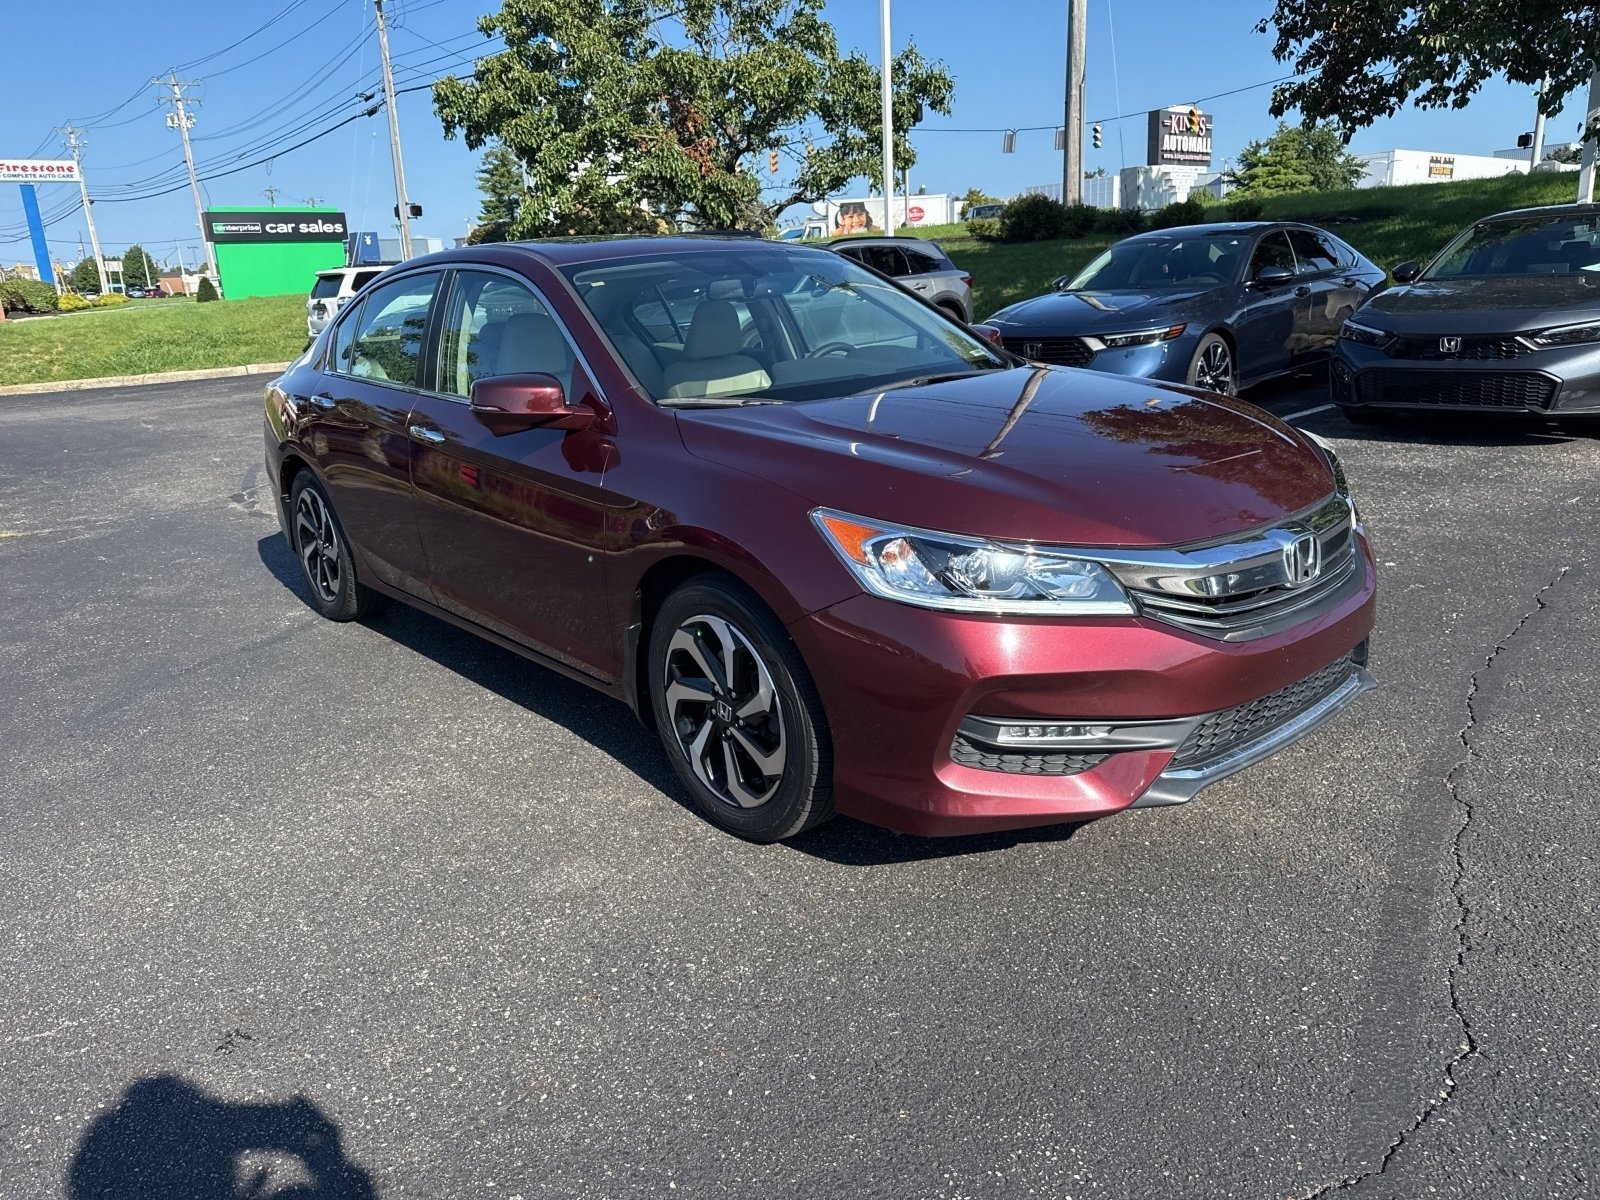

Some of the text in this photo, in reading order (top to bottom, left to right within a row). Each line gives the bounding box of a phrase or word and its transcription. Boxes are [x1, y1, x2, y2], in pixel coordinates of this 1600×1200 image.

[1170, 114, 1206, 136] KINS
[1163, 134, 1211, 153] AUTOMALL
[216, 219, 344, 233] enterprise car sales
